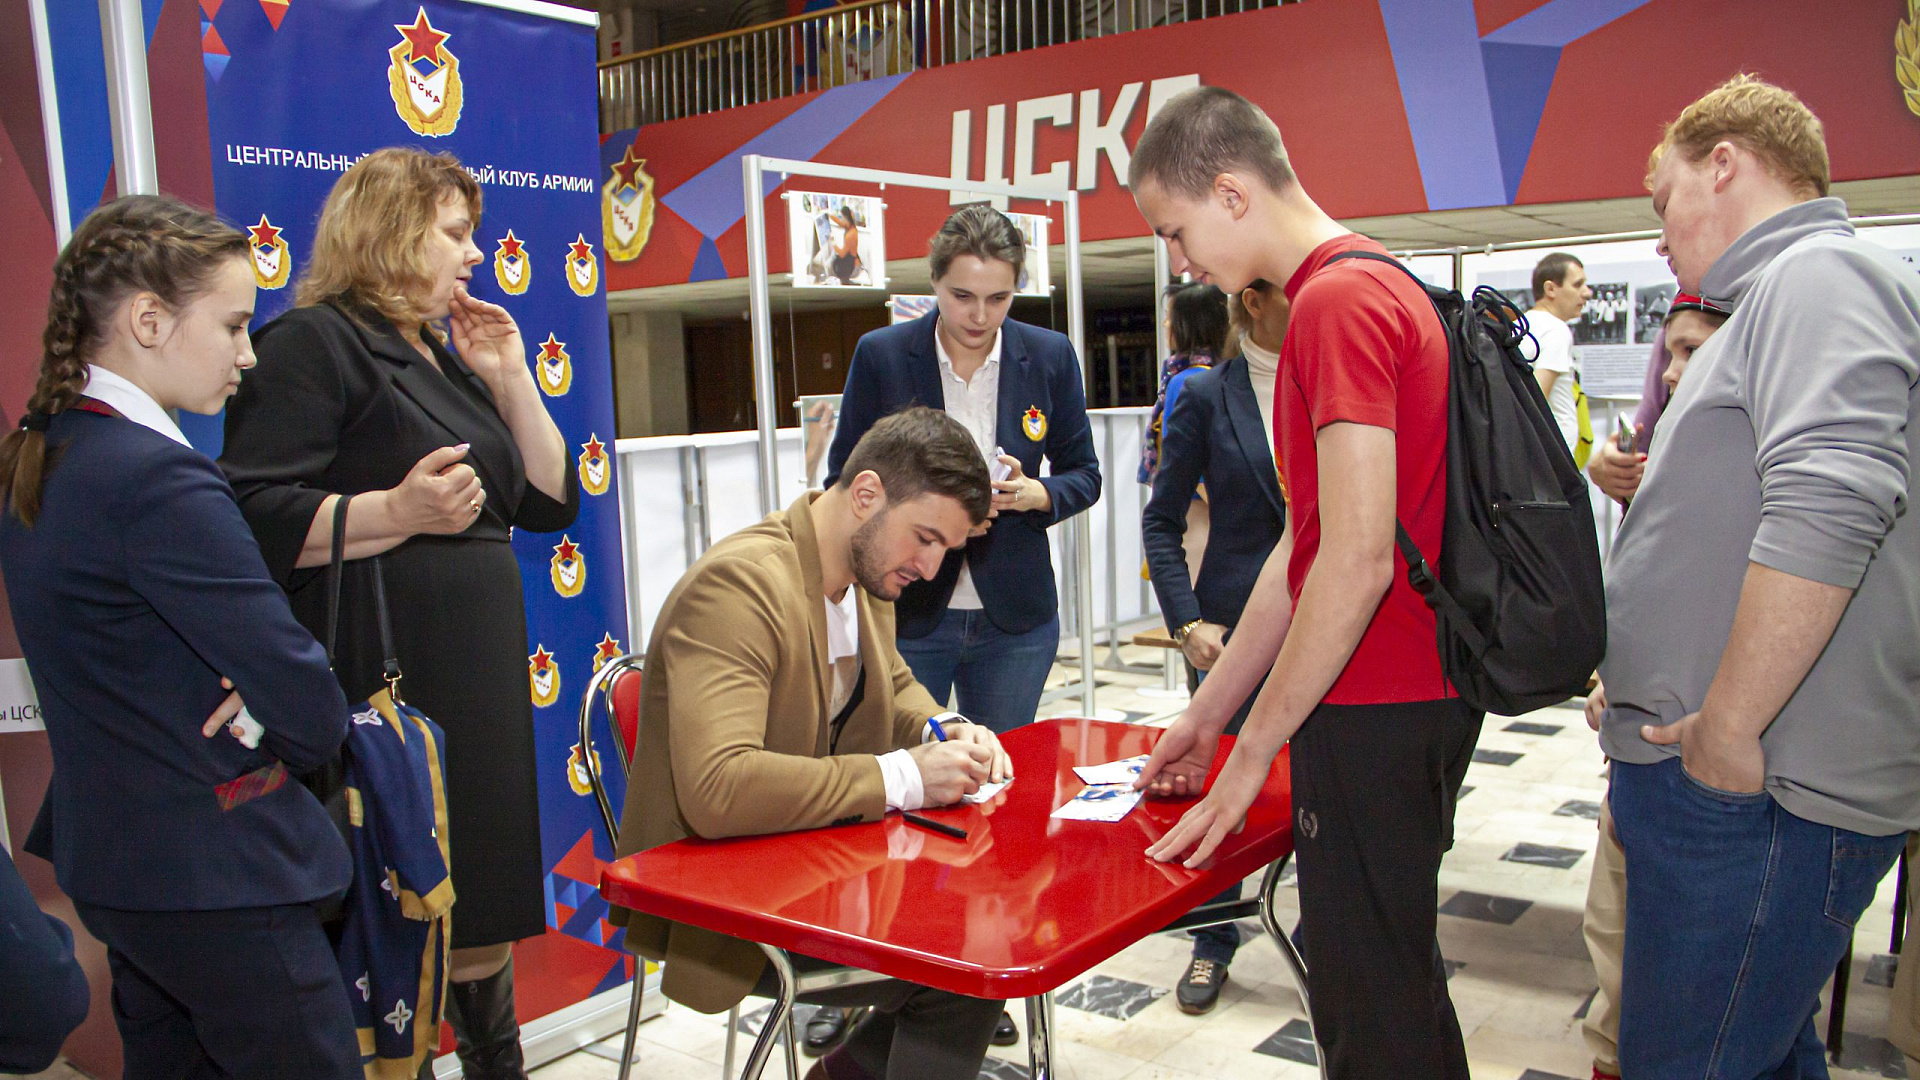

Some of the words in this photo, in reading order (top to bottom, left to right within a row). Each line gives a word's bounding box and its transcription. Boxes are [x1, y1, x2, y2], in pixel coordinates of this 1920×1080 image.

[410, 75, 441, 104] ЦСКА
[499, 169, 539, 189] КЛУБ
[542, 174, 594, 194] АРМИИ
[11, 704, 42, 723] ЦСК
